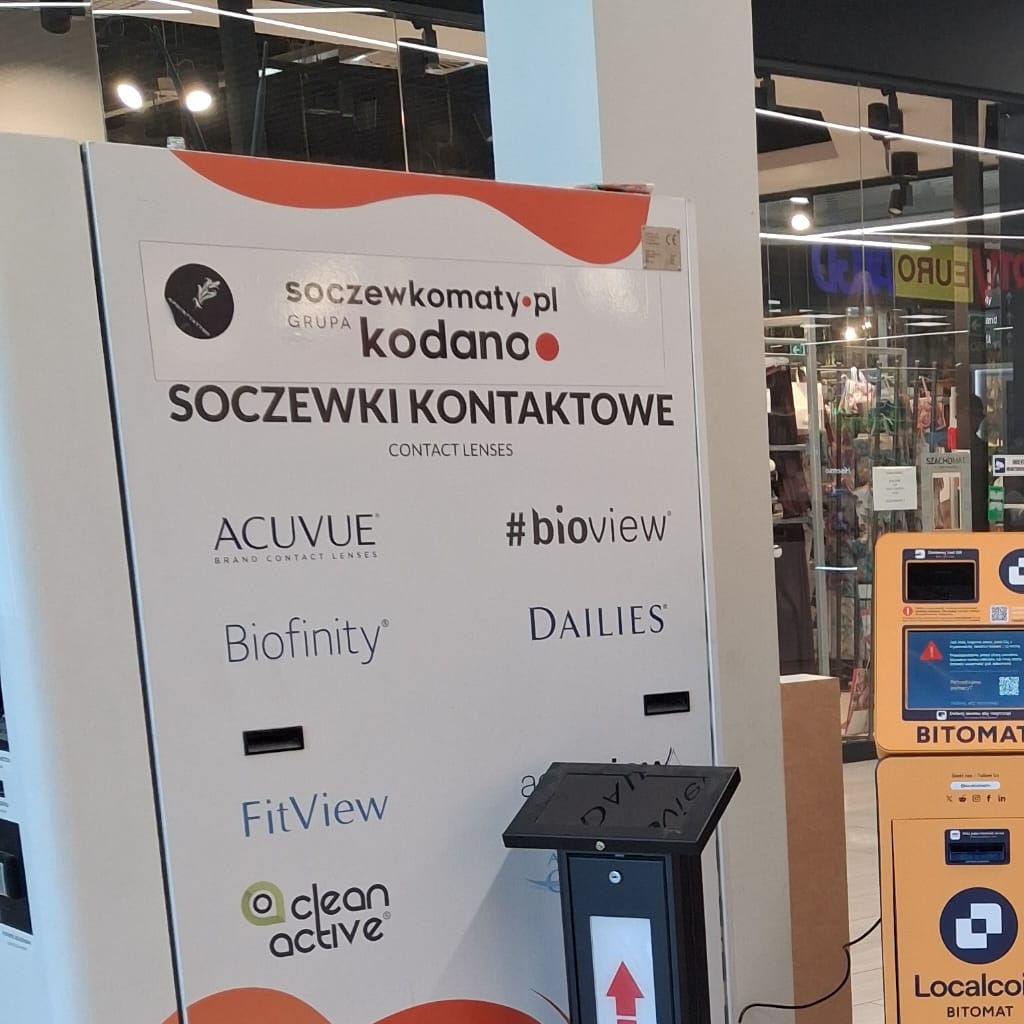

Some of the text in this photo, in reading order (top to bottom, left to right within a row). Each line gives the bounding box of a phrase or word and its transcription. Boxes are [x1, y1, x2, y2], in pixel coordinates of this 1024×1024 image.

[287, 314, 531, 361] GRUPA kodano
[169, 383, 675, 427] SOCZEWKI KONTAKTOWE
[388, 442, 513, 457] CONTACT LENSES
[214, 514, 377, 551] ACUVUE
[214, 551, 378, 564] BRAND CONTACT LENSES
[225, 616, 381, 665] Biofinity
[529, 604, 666, 641] DAILIES
[241, 793, 389, 838] FitView
[290, 883, 390, 920] clean
[269, 916, 385, 958] active
[946, 1006, 1014, 1018] BITOMAT
